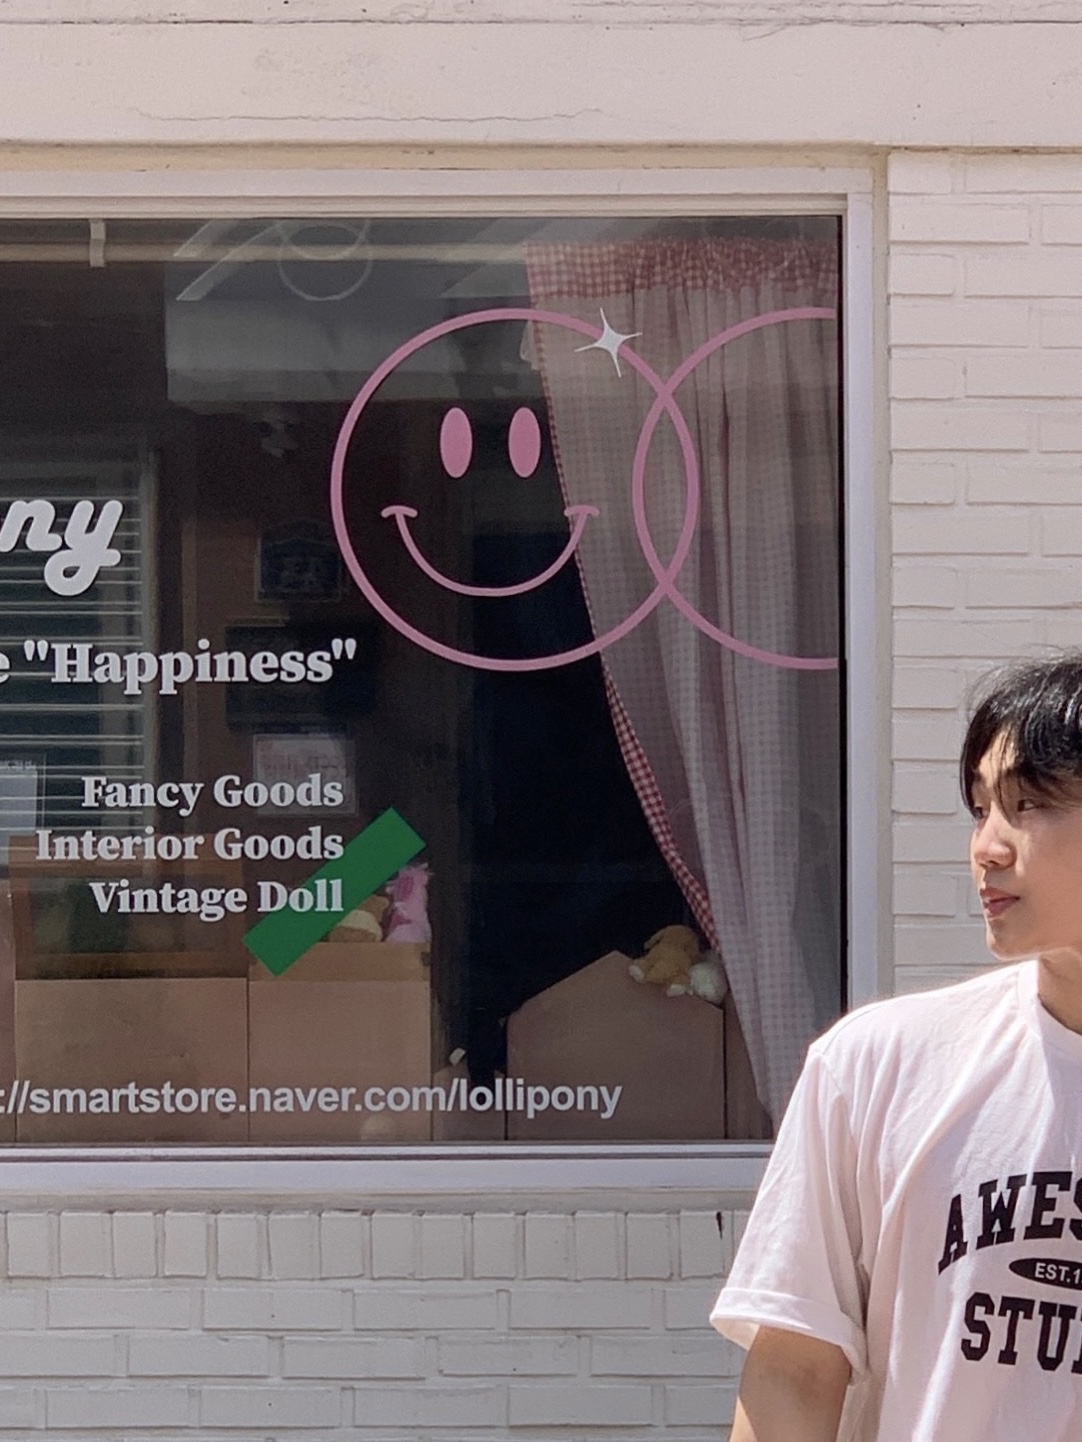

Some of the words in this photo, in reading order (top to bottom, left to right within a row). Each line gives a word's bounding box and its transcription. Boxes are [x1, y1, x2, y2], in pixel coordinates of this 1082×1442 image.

[23, 638, 357, 695] "Happiness"
[81, 775, 204, 817] Fancy
[213, 773, 345, 808] Goods
[35, 826, 205, 861] Interior
[213, 825, 346, 860] Goods
[88, 878, 248, 922] Vintage
[257, 878, 344, 913] Doll
